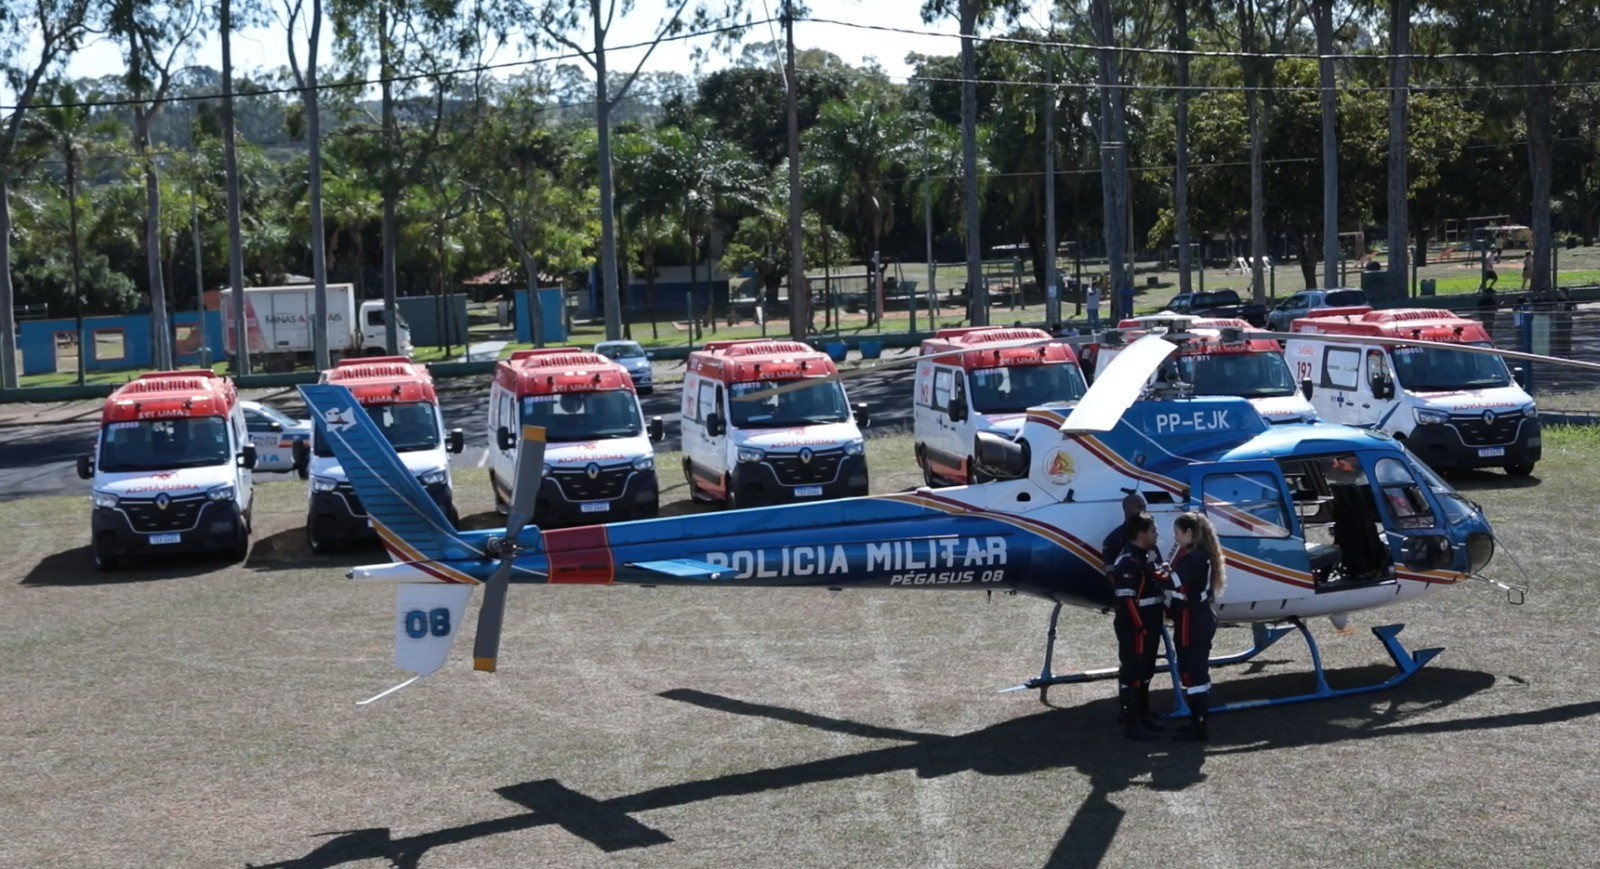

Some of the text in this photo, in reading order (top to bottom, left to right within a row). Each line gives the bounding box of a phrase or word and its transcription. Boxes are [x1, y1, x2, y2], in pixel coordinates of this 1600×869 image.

[265, 313, 297, 325] MINAS
[1297, 361, 1312, 380] 192
[1156, 409, 1230, 434] PP-EJK
[866, 536, 1008, 571] MILITAR
[890, 569, 1005, 586] PÉGASUS 08
[405, 606, 451, 639] 08
